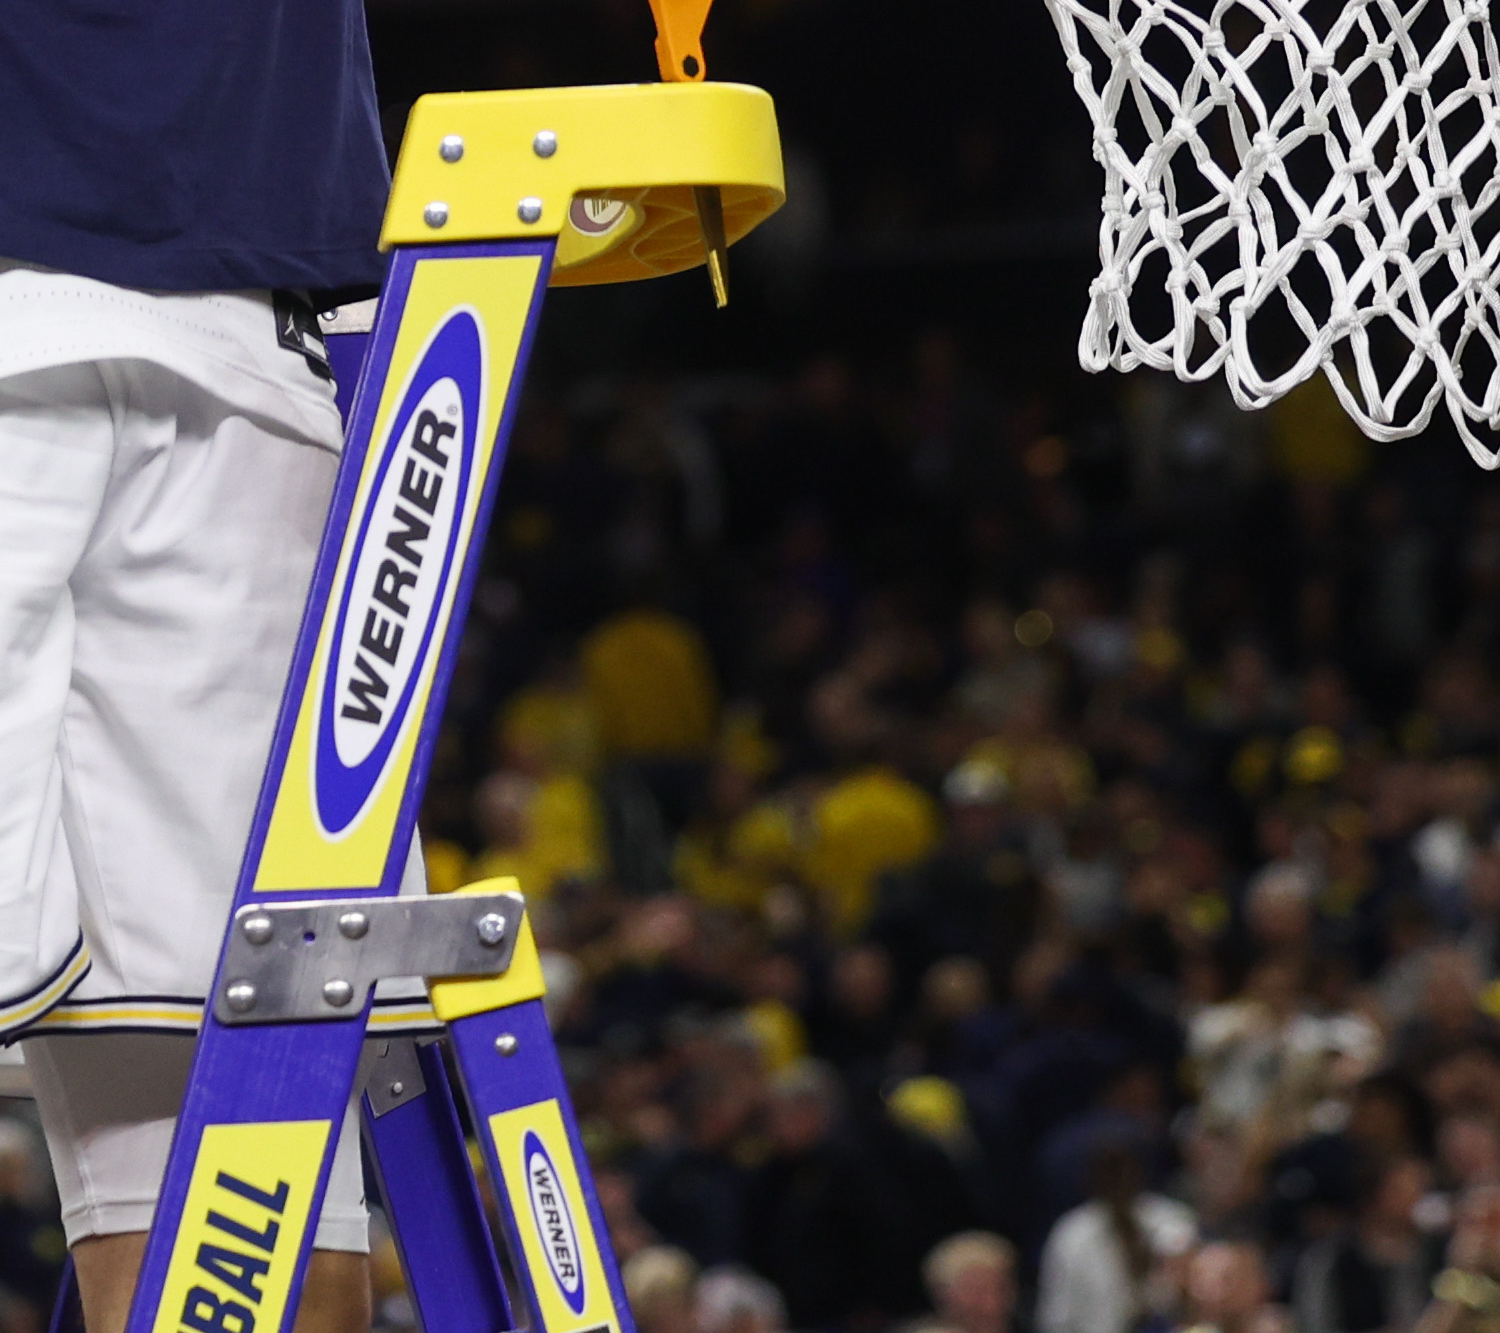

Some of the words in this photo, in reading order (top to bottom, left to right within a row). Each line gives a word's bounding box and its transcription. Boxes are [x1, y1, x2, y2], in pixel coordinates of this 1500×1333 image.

[341, 406, 457, 726] WERNER
[177, 1170, 290, 1333] BALL
[530, 1166, 577, 1283] WERNER
